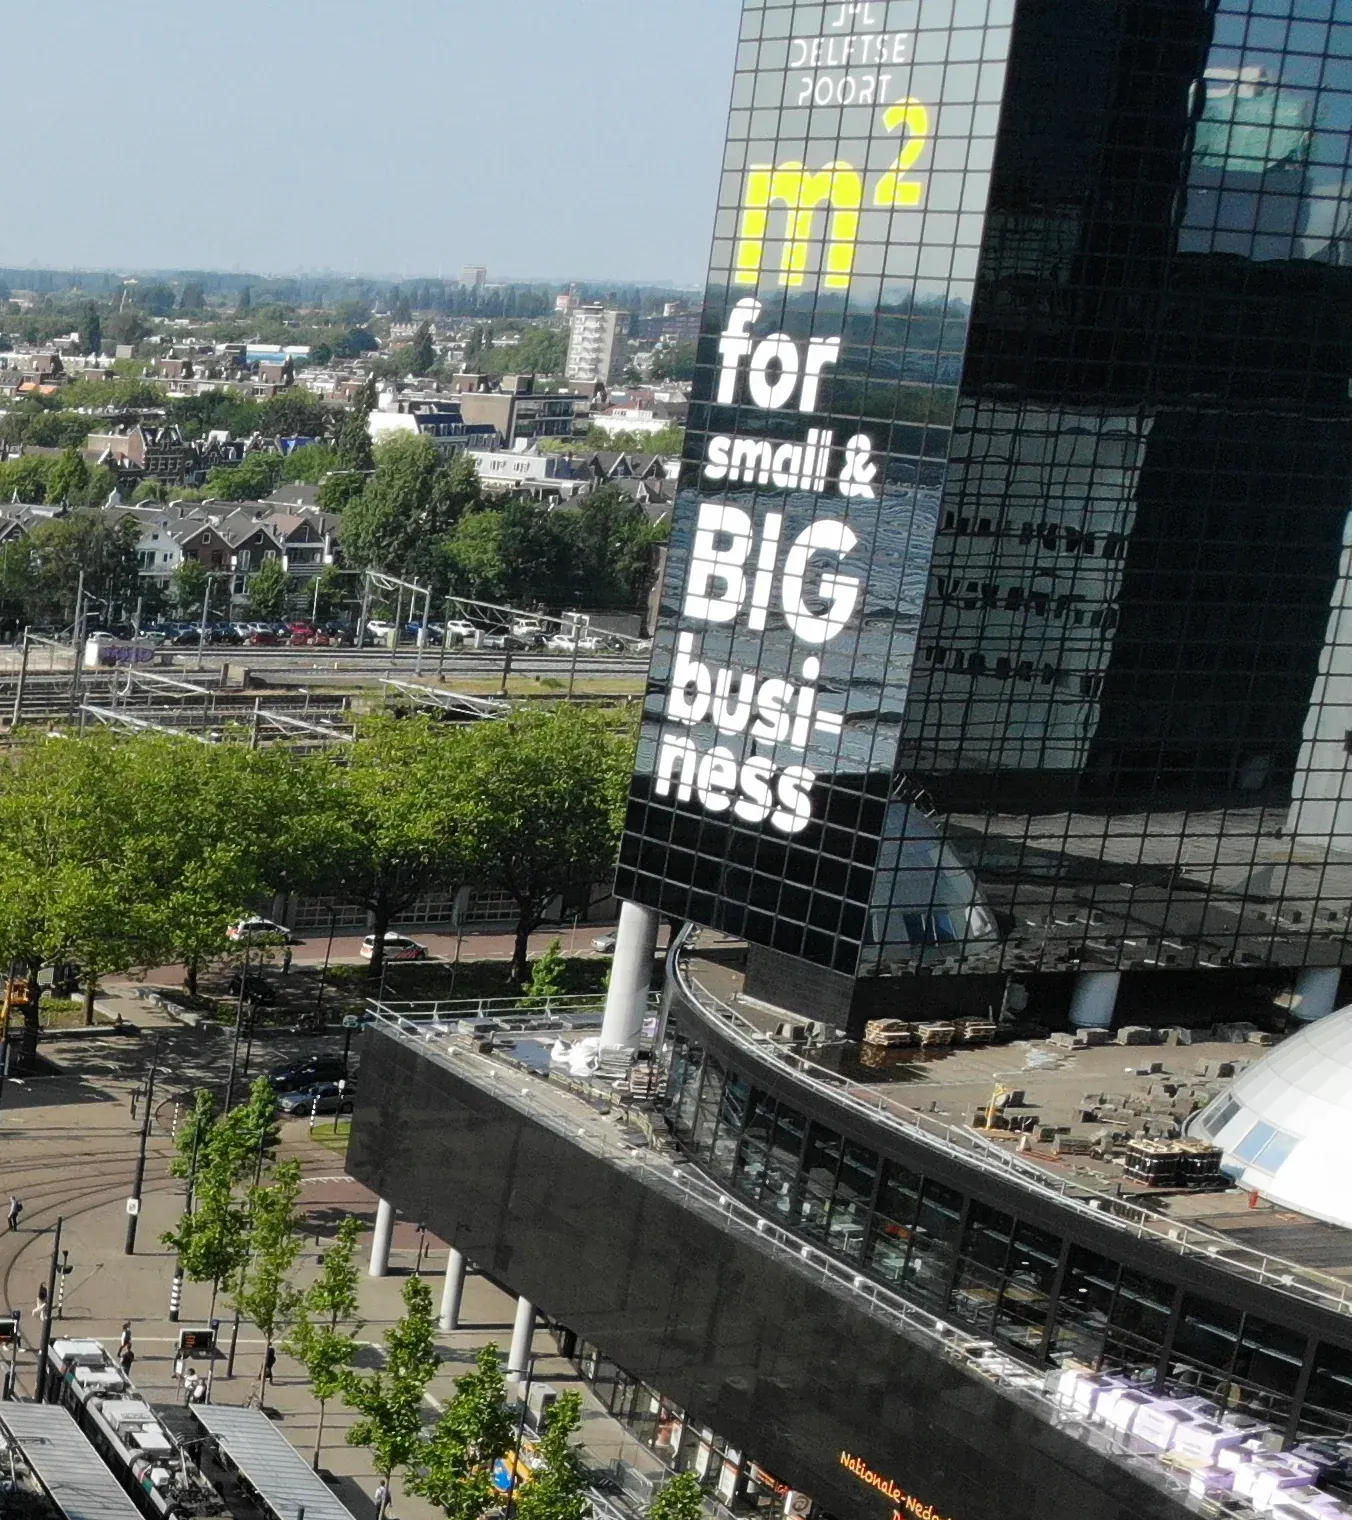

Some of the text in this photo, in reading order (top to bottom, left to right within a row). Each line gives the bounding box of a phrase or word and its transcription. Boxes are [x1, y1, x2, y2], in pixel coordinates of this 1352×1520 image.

[790, 33, 908, 68] DELFTSE
[798, 74, 893, 106] POORT
[717, 297, 841, 413] for
[704, 428, 877, 499] small &
[682, 503, 860, 644] BIG
[667, 632, 844, 752] busi-
[655, 732, 817, 834] ness
